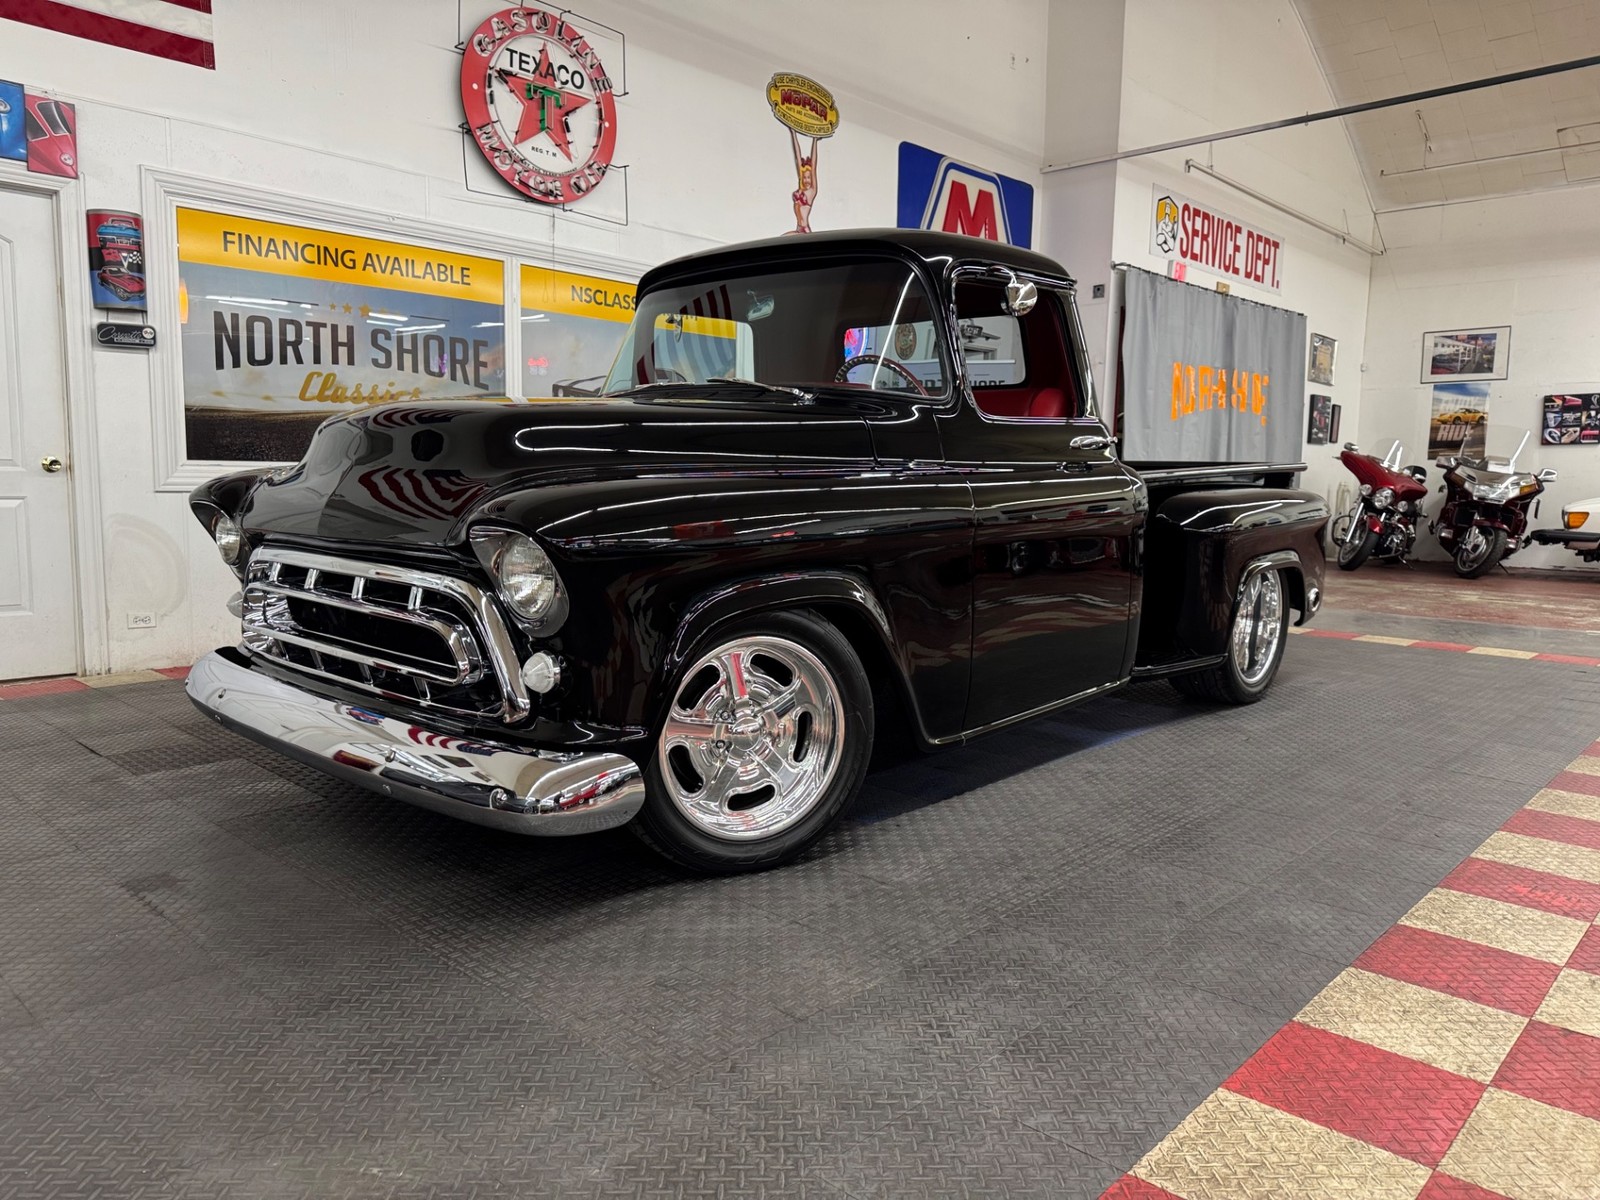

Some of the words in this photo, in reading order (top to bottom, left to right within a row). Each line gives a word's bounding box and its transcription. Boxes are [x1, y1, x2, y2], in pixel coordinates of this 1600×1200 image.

[505, 48, 584, 90] TEXACO
[781, 88, 828, 122] MOPAR
[942, 180, 998, 241] M
[222, 231, 356, 270] FINANCING
[361, 253, 471, 286] AVAILABLE
[1179, 203, 1242, 275] SERVICE
[1244, 229, 1280, 289] DEPT.
[213, 311, 355, 370] NORTH
[370, 328, 490, 391] SHORE
